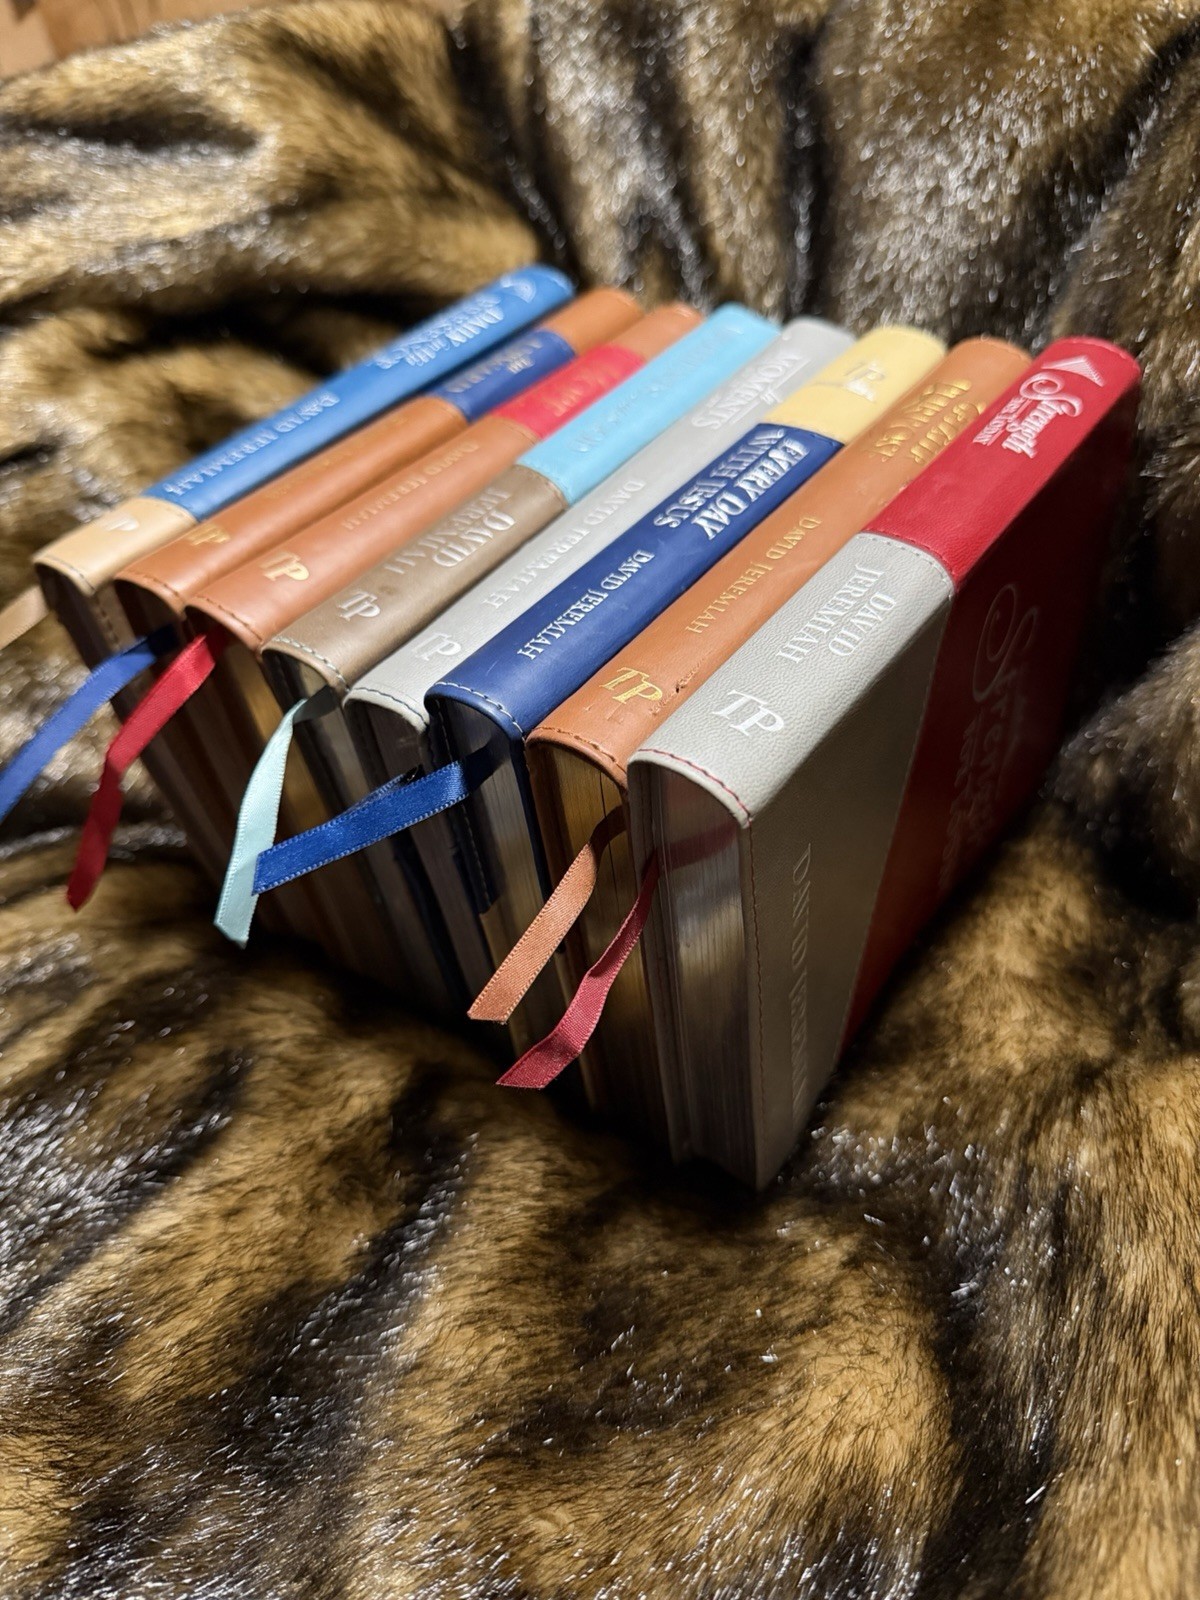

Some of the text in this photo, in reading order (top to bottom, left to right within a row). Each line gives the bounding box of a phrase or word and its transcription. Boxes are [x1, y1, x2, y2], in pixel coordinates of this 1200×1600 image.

[449, 302, 504, 347] DAILY
[275, 391, 341, 434] DAVID
[690, 350, 803, 430] MOMENTS
[1002, 371, 1083, 459] Strength
[163, 428, 278, 497] JEREMIAH
[423, 440, 480, 477] DAVID
[653, 428, 787, 528] WITH JESUS
[690, 437, 810, 541] EVERY DAY
[340, 474, 428, 531] JEREMIAH
[383, 486, 512, 575] JEREMIAH
[432, 509, 516, 568] DAVID
[482, 478, 647, 610] DAVID JEREMIAH
[336, 588, 381, 622] TP
[516, 549, 656, 660] DAVID JEREMIAH
[685, 516, 823, 634] DAVID JEREMIAH
[412, 631, 462, 662] TP
[775, 563, 885, 664] JEREMIAH
[828, 591, 897, 657] DAVID
[599, 666, 663, 704] TP
[712, 689, 784, 737] TP
[792, 842, 811, 974] DAVID
